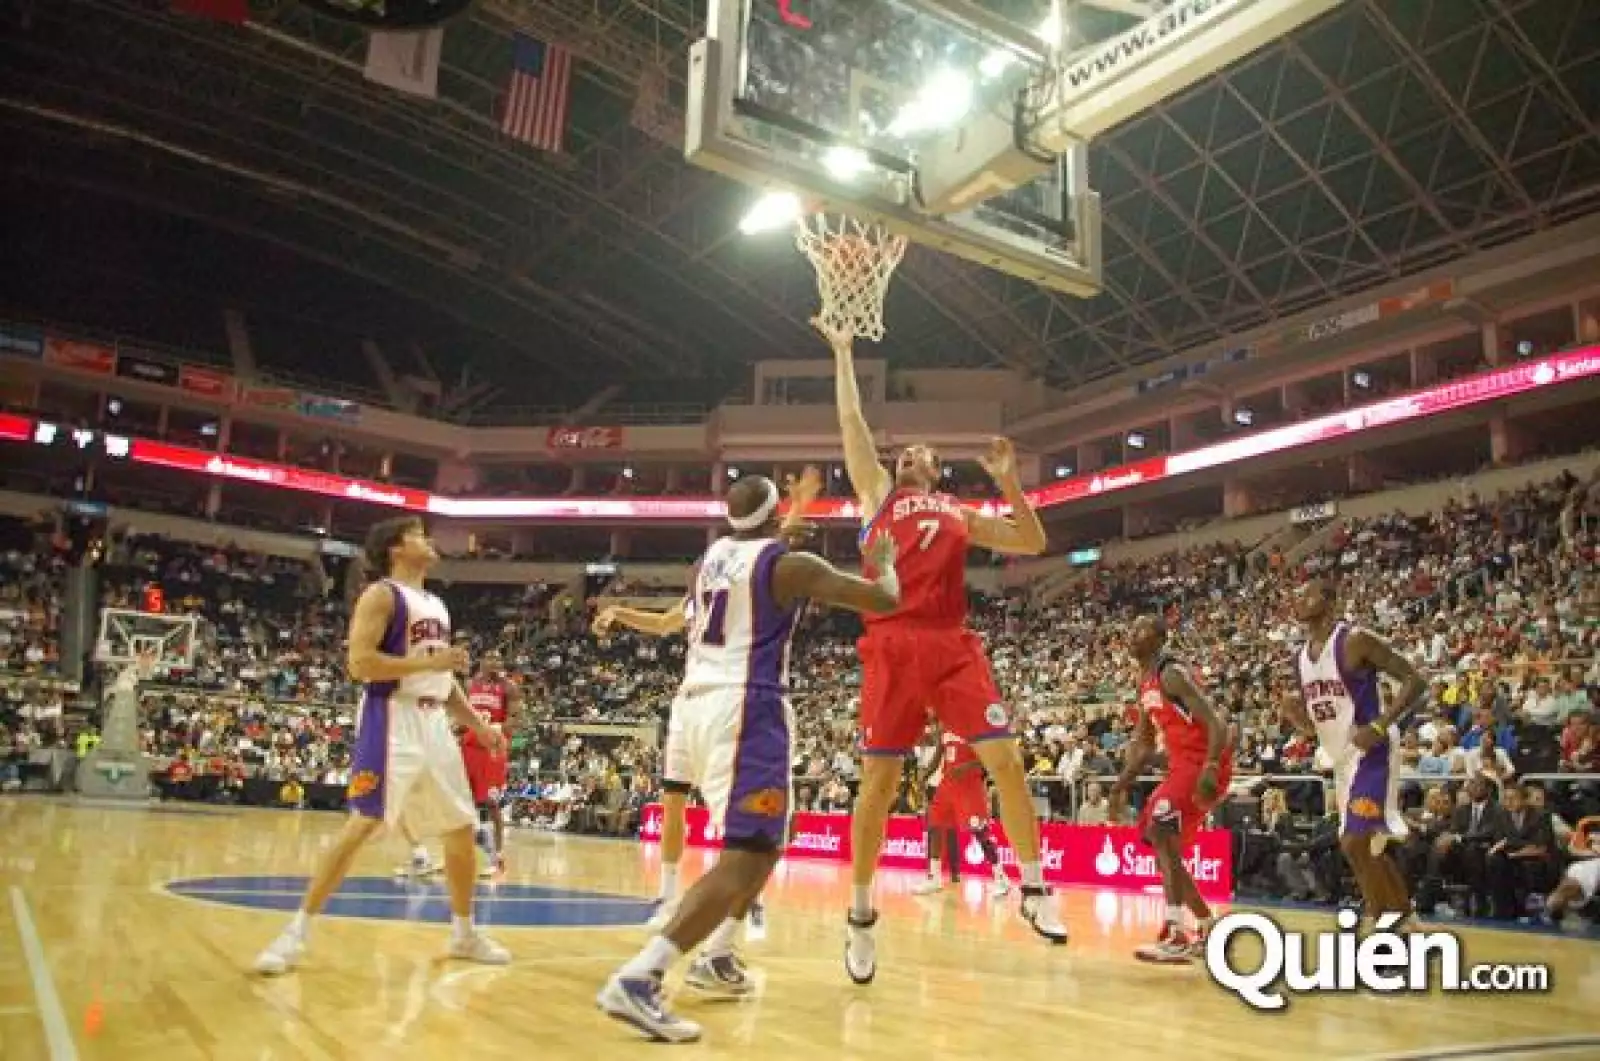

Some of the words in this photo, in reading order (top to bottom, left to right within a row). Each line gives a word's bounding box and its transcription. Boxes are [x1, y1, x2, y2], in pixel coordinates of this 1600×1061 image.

[917, 519, 940, 551] 7
[791, 824, 841, 851] antander
[879, 831, 928, 858] antand
[1121, 842, 1222, 882] Sander
